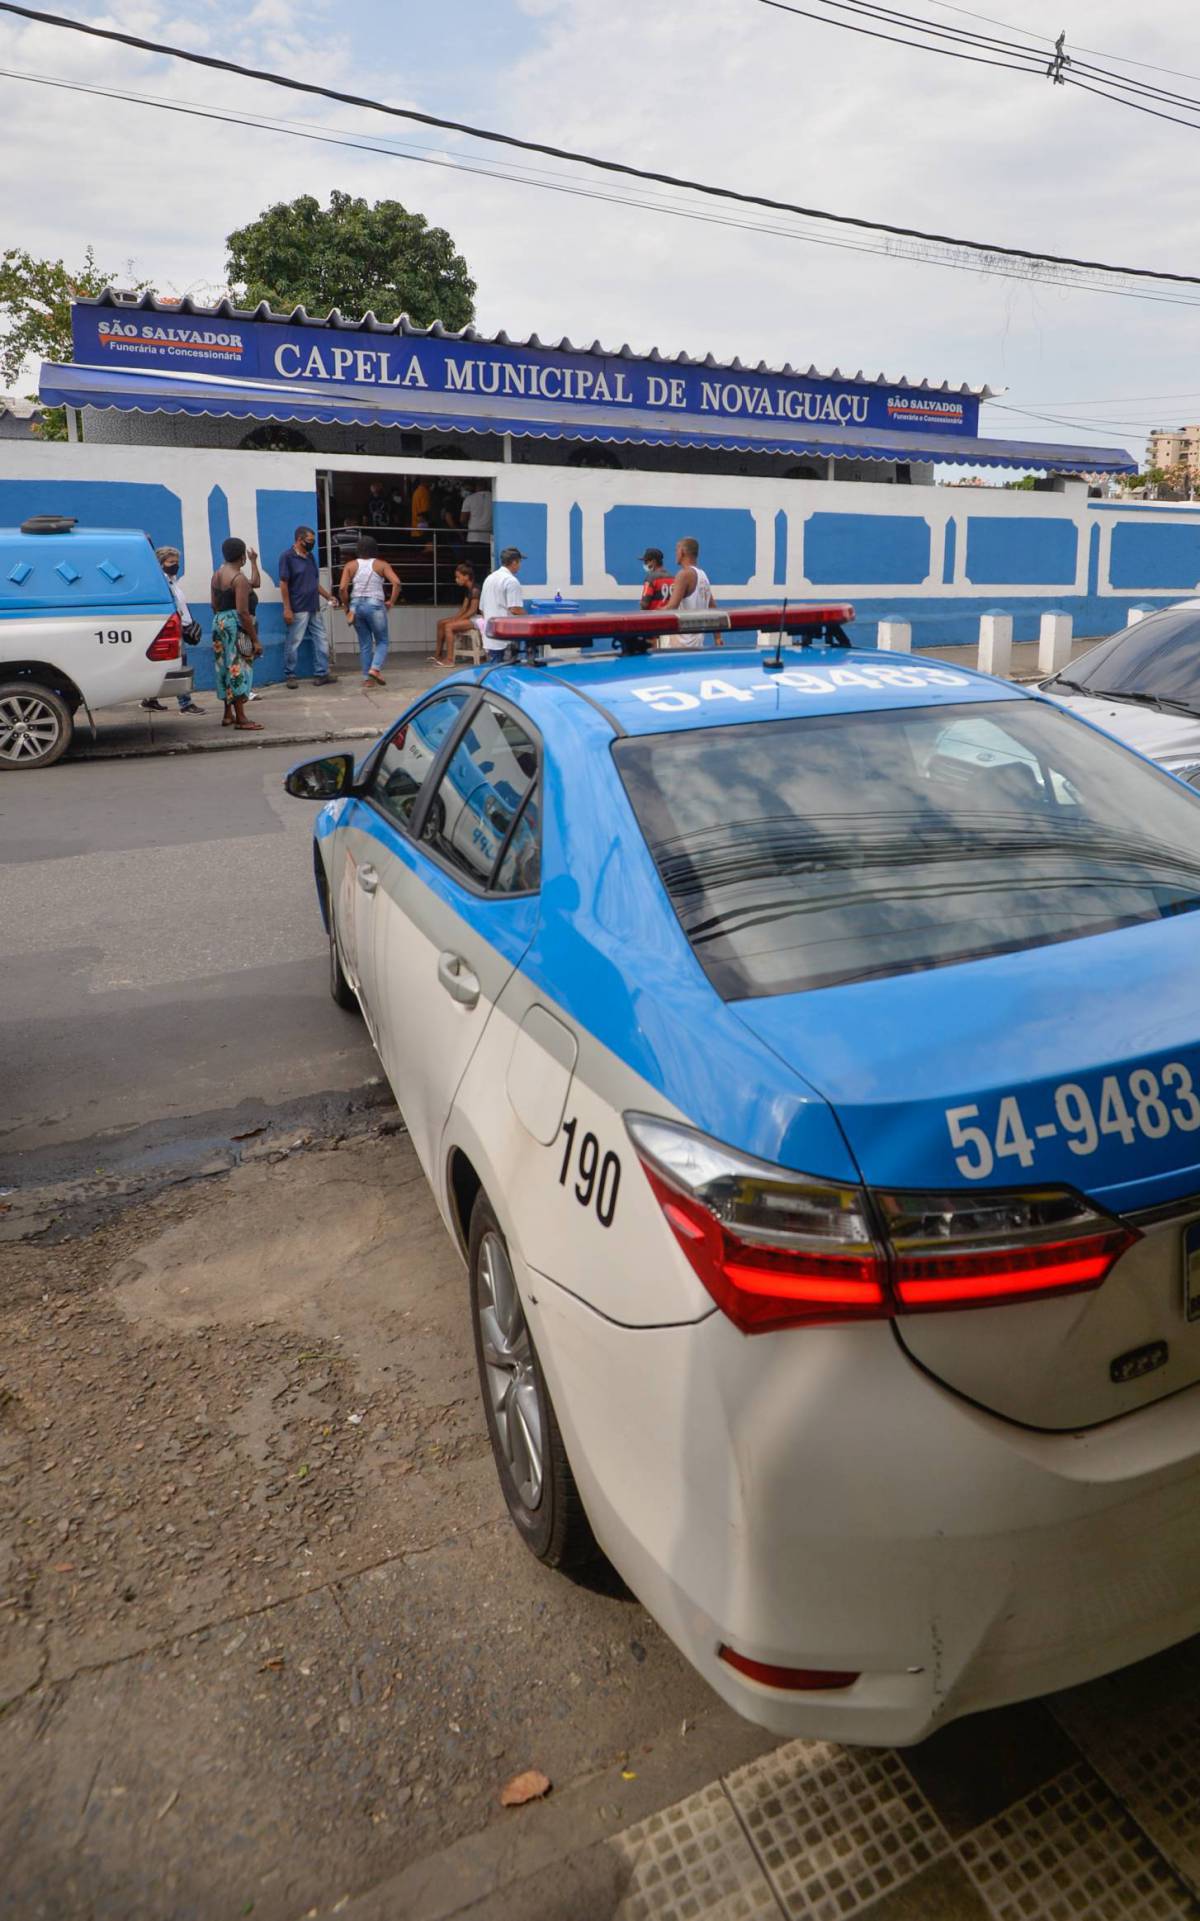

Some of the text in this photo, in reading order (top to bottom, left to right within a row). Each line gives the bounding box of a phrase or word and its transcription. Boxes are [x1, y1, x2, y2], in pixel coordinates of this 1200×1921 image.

[98, 319, 243, 347] SÃO SALVADOR
[109, 341, 157, 354] Funerária
[167, 346, 242, 361] Concessionária
[274, 343, 428, 388] CAPELA
[444, 358, 633, 403] MUNICIPAL
[646, 376, 687, 408] DE
[887, 395, 963, 414] SÃO SALVADOR
[94, 630, 132, 644] 190
[631, 667, 970, 712] 54-9483
[945, 1062, 1200, 1180] 54-9483
[559, 1116, 621, 1228] 190
